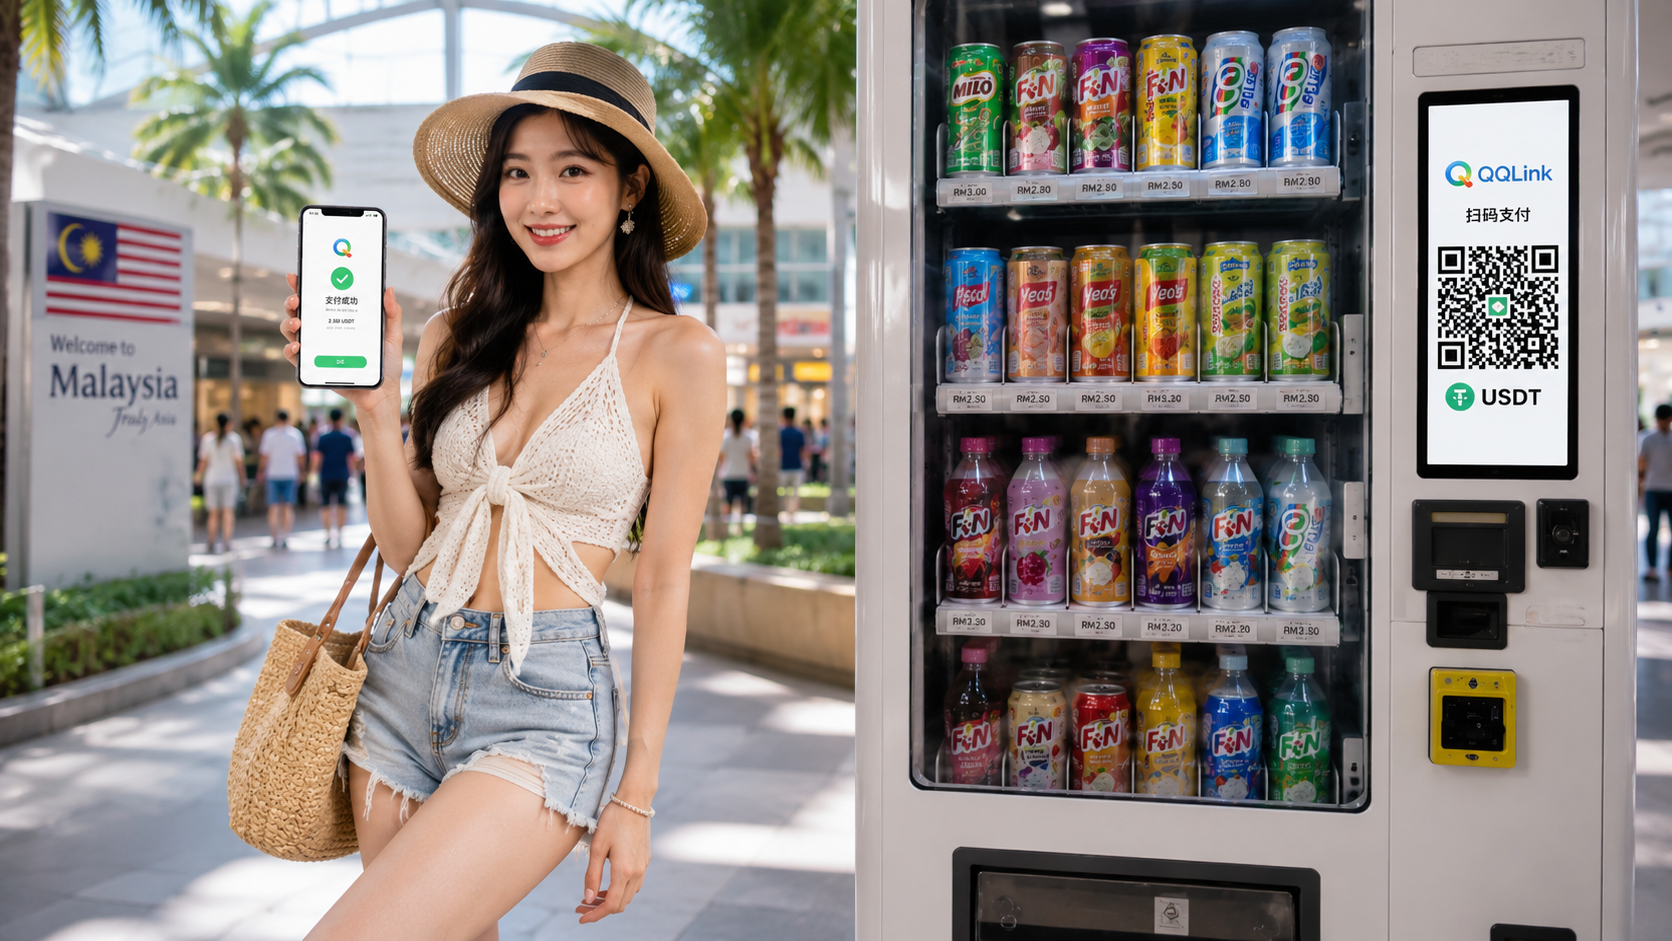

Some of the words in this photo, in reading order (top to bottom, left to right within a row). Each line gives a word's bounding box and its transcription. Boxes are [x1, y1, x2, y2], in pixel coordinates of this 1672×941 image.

[953, 79, 993, 100] MILO
[1478, 164, 1553, 183] QQLink
[1465, 206, 1531, 223] 扫码支付
[325, 295, 359, 306] 支付成功
[50, 334, 118, 356] Welcome
[120, 340, 136, 357] to
[50, 362, 178, 407] Malaysia
[1481, 388, 1542, 406] USDT
